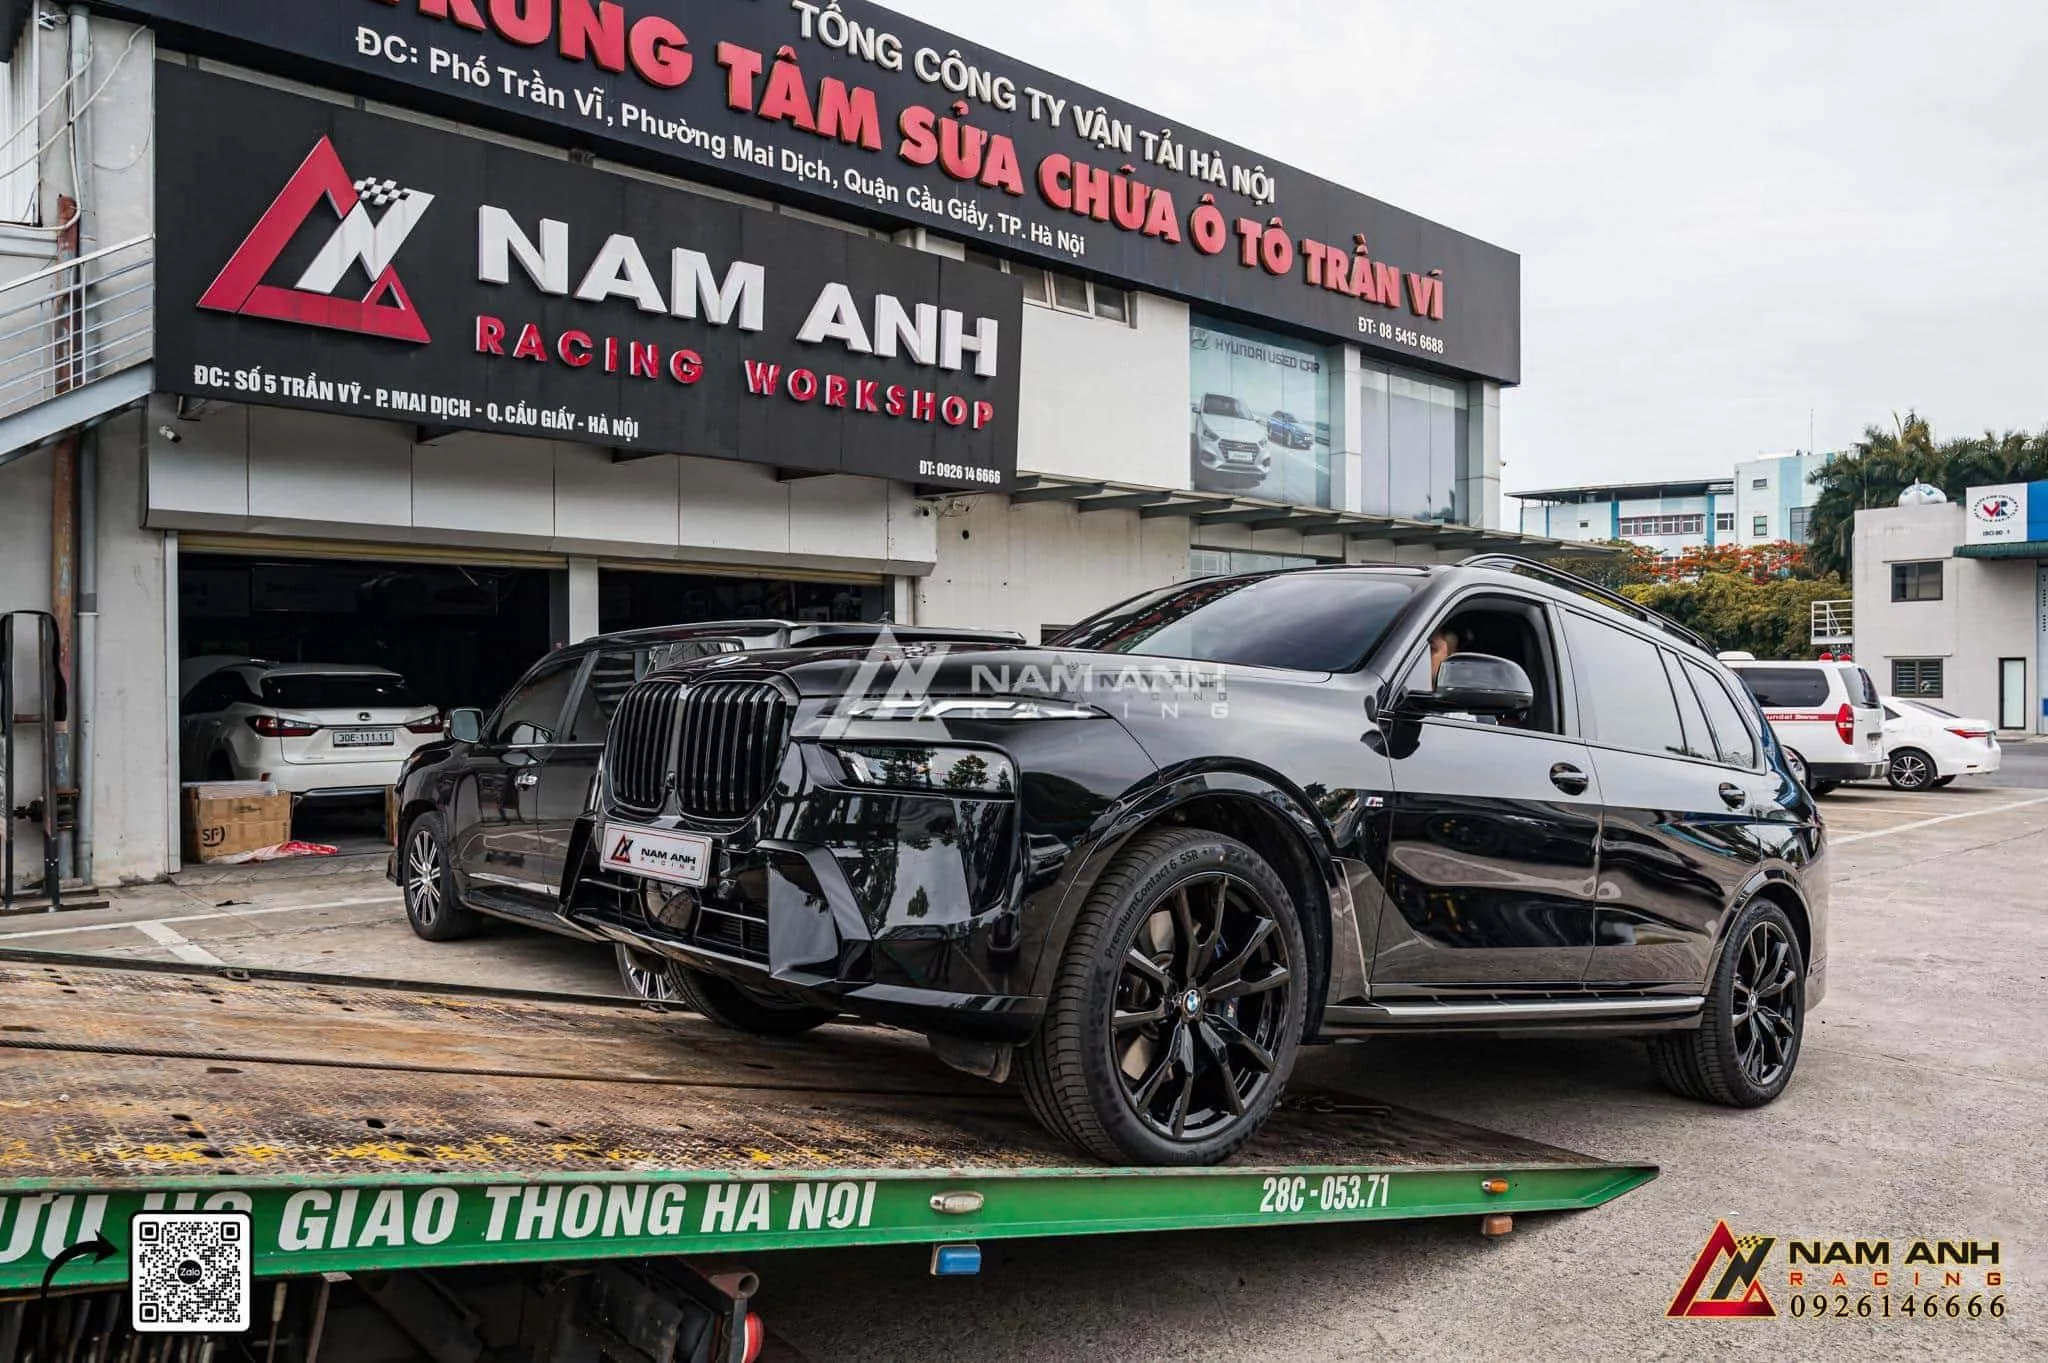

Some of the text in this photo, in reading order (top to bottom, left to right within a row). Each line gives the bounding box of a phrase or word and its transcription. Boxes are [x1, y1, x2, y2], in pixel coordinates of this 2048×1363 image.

[355, 26, 419, 64] ĐC:
[429, 47, 491, 88] Phố
[497, 66, 565, 110] Trần
[621, 101, 726, 160] Phường
[733, 134, 774, 168] Mai
[781, 148, 839, 189] Dịch,
[844, 168, 899, 205] Quận
[906, 185, 943, 216] Cầu
[947, 199, 994, 234] Giấy,
[998, 212, 1027, 239] TP.
[1031, 222, 1053, 247] Hà
[1058, 230, 1085, 258] Nội
[717, 44, 882, 151] TÂM
[899, 100, 1024, 197] SỬA
[1038, 151, 1182, 243] CHỮA
[1188, 192, 1227, 255] Ô
[1236, 216, 1294, 276] TÔ
[914, 48, 1016, 112] CÔNG
[1024, 86, 1066, 128] TY
[1072, 105, 1132, 153] VẬN
[1138, 128, 1183, 172] TẢI
[1189, 149, 1228, 187] HÀ
[1231, 164, 1275, 206] NỘI
[478, 203, 999, 377] NAM ANH
[1379, 321, 1393, 340] 08
[1395, 327, 1418, 347] 5415
[194, 364, 230, 387] ĐC:
[234, 365, 261, 392] SỐ
[264, 374, 277, 394] 5
[280, 372, 334, 400] TRẦN
[337, 381, 362, 404] VỸ
[392, 390, 426, 412] MAI
[430, 395, 471, 420] DỊCH
[505, 400, 537, 426] CẦU
[541, 405, 576, 431] GIẤY
[588, 413, 609, 435] HÀ
[613, 416, 639, 442] NỘI
[475, 314, 994, 430] RACING WORKSHOP
[937, 462, 963, 480] 0926
[641, 847, 696, 864] NAM ANH
[278, 1187, 460, 1252] GIAO
